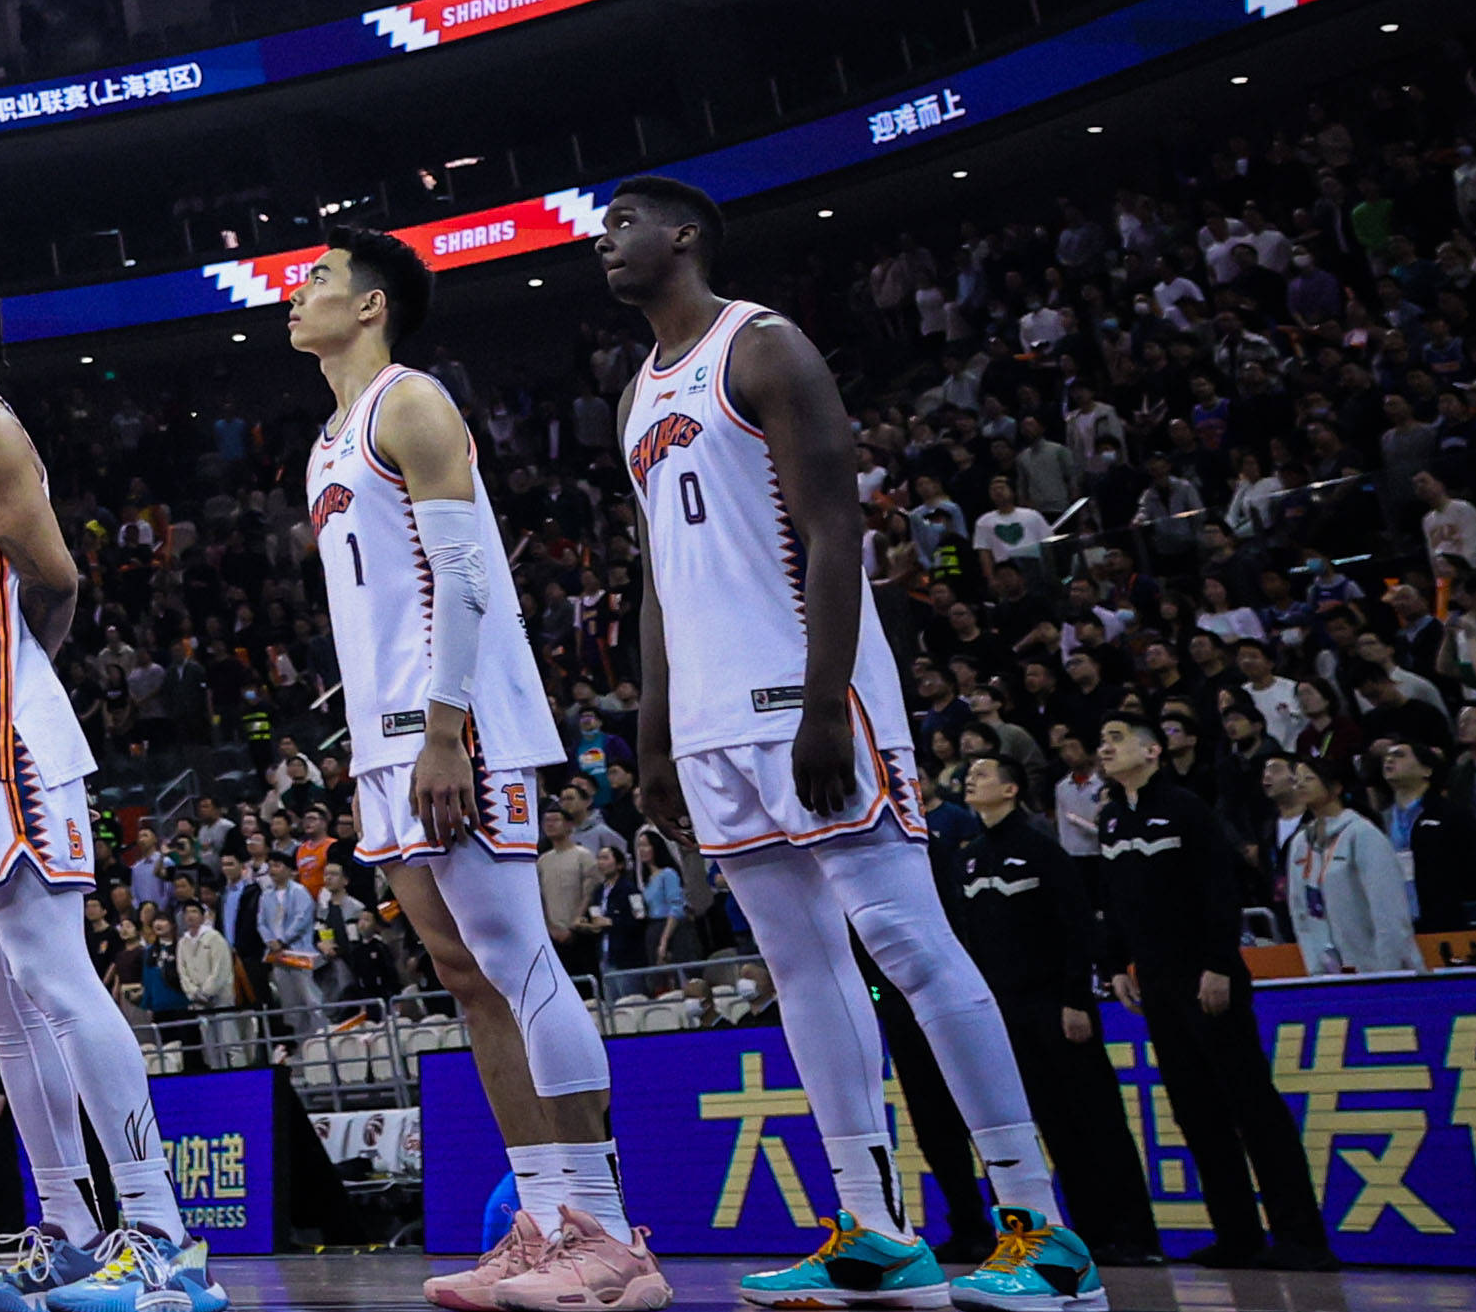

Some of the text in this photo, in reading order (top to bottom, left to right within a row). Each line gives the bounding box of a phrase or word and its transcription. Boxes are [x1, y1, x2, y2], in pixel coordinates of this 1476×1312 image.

[868, 88, 966, 145] 迎难而上
[432, 219, 516, 257] SHARKS
[679, 471, 707, 526] 0
[345, 532, 366, 587] 1
